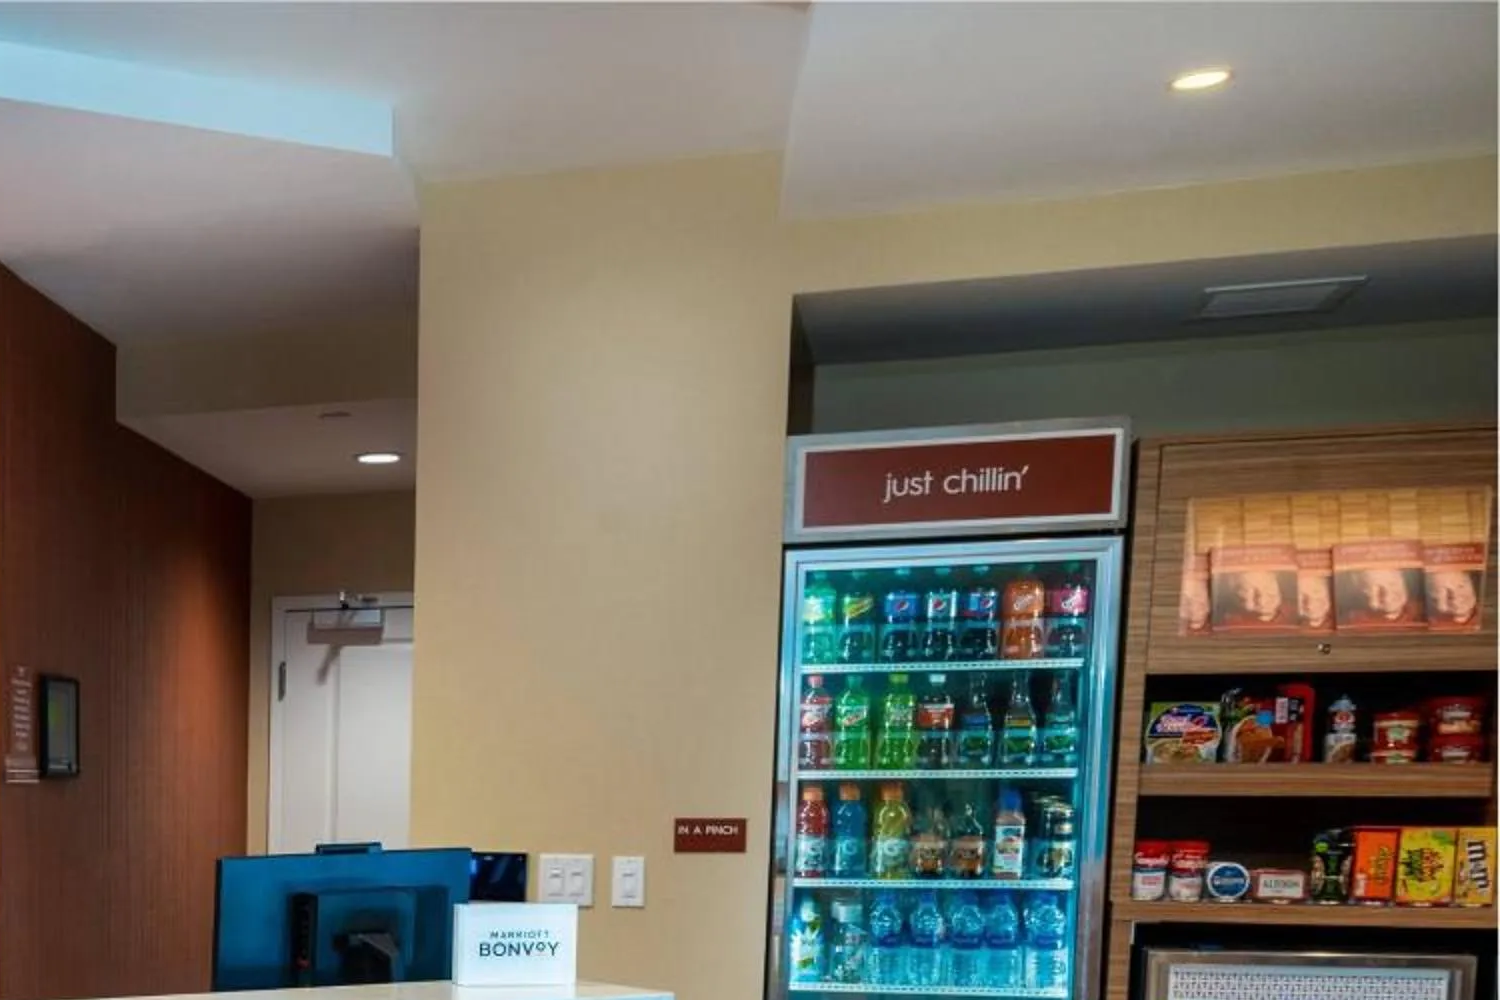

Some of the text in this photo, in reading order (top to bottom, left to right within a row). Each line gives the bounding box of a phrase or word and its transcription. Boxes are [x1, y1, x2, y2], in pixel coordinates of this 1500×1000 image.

[883, 470, 934, 503] just
[677, 824, 739, 836] IN A PINCH
[489, 930, 549, 939] MARRIOTT
[479, 941, 560, 957] BONVOY
